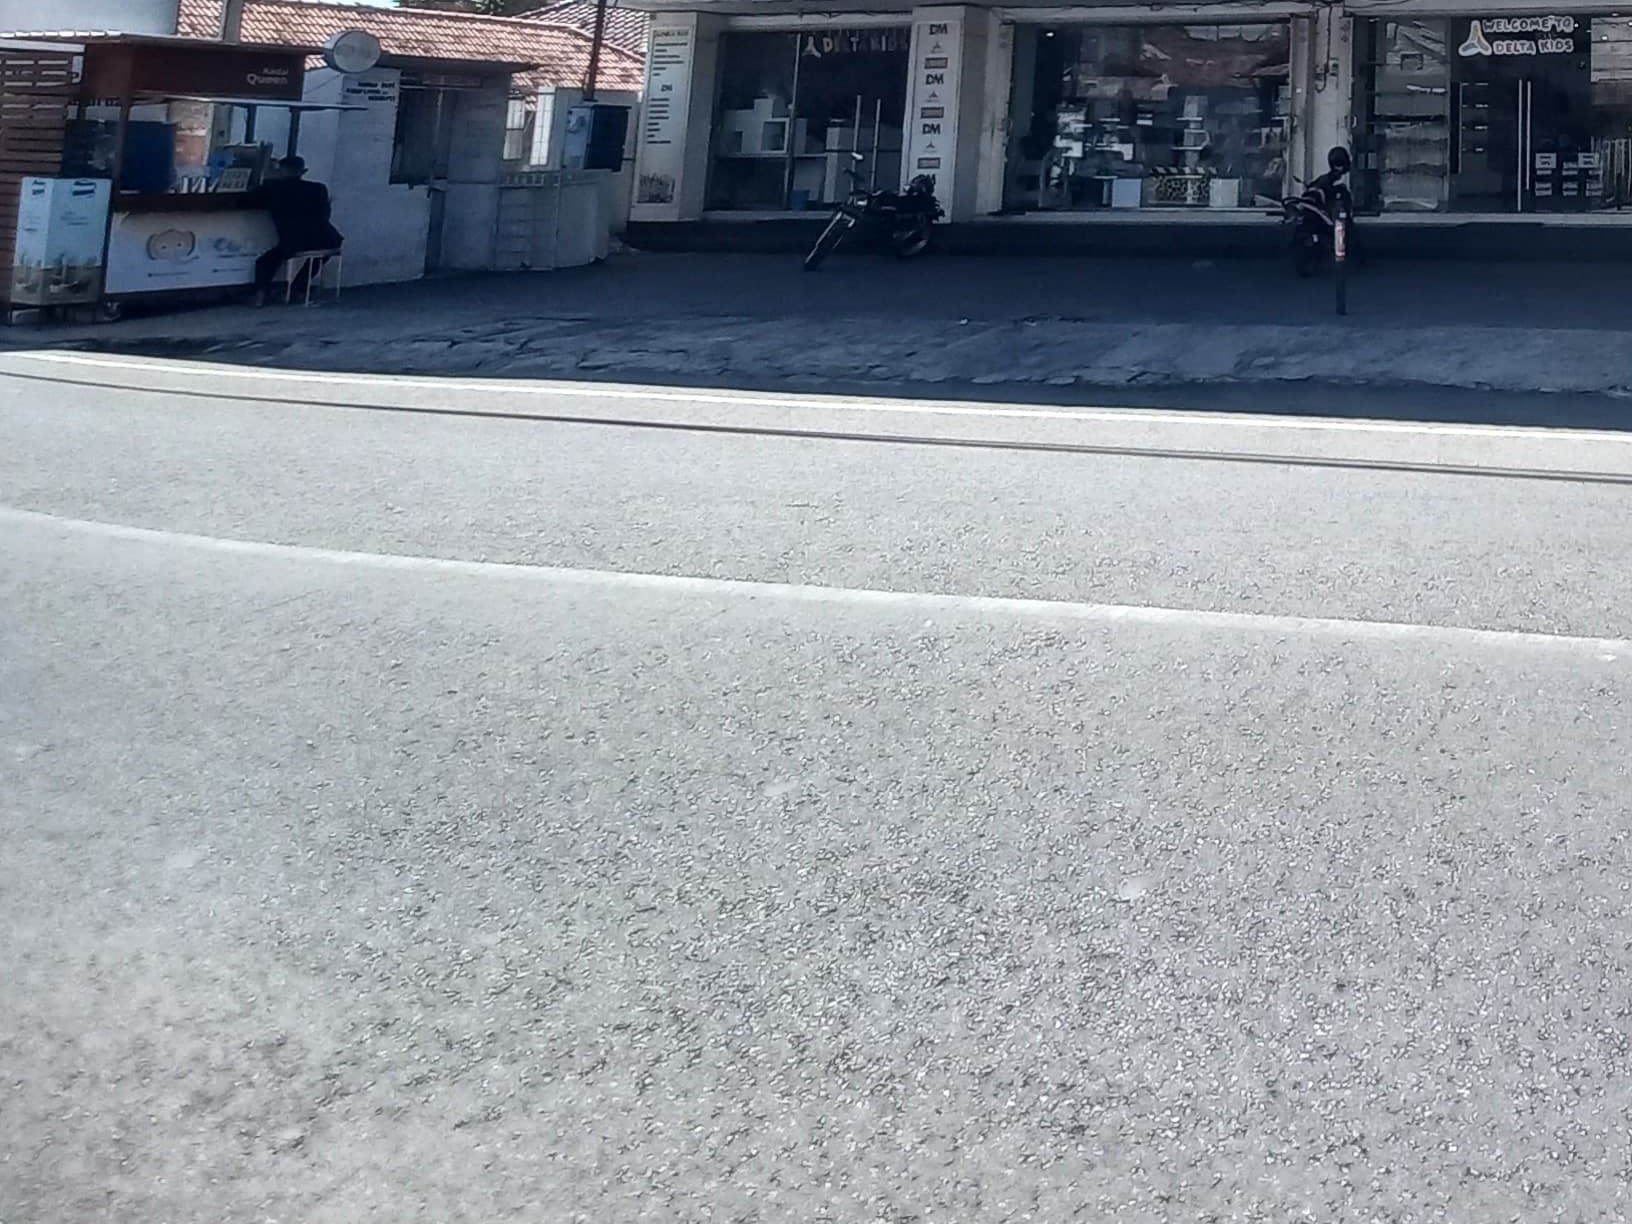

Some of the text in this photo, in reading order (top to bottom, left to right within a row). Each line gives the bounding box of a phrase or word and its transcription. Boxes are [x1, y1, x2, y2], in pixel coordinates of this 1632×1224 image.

[929, 23, 948, 35] DM
[1482, 16, 1574, 33] WELCOME TO
[1493, 38, 1574, 54] DELTA KIDS
[925, 73, 944, 85] DM
[922, 123, 941, 135] DM
